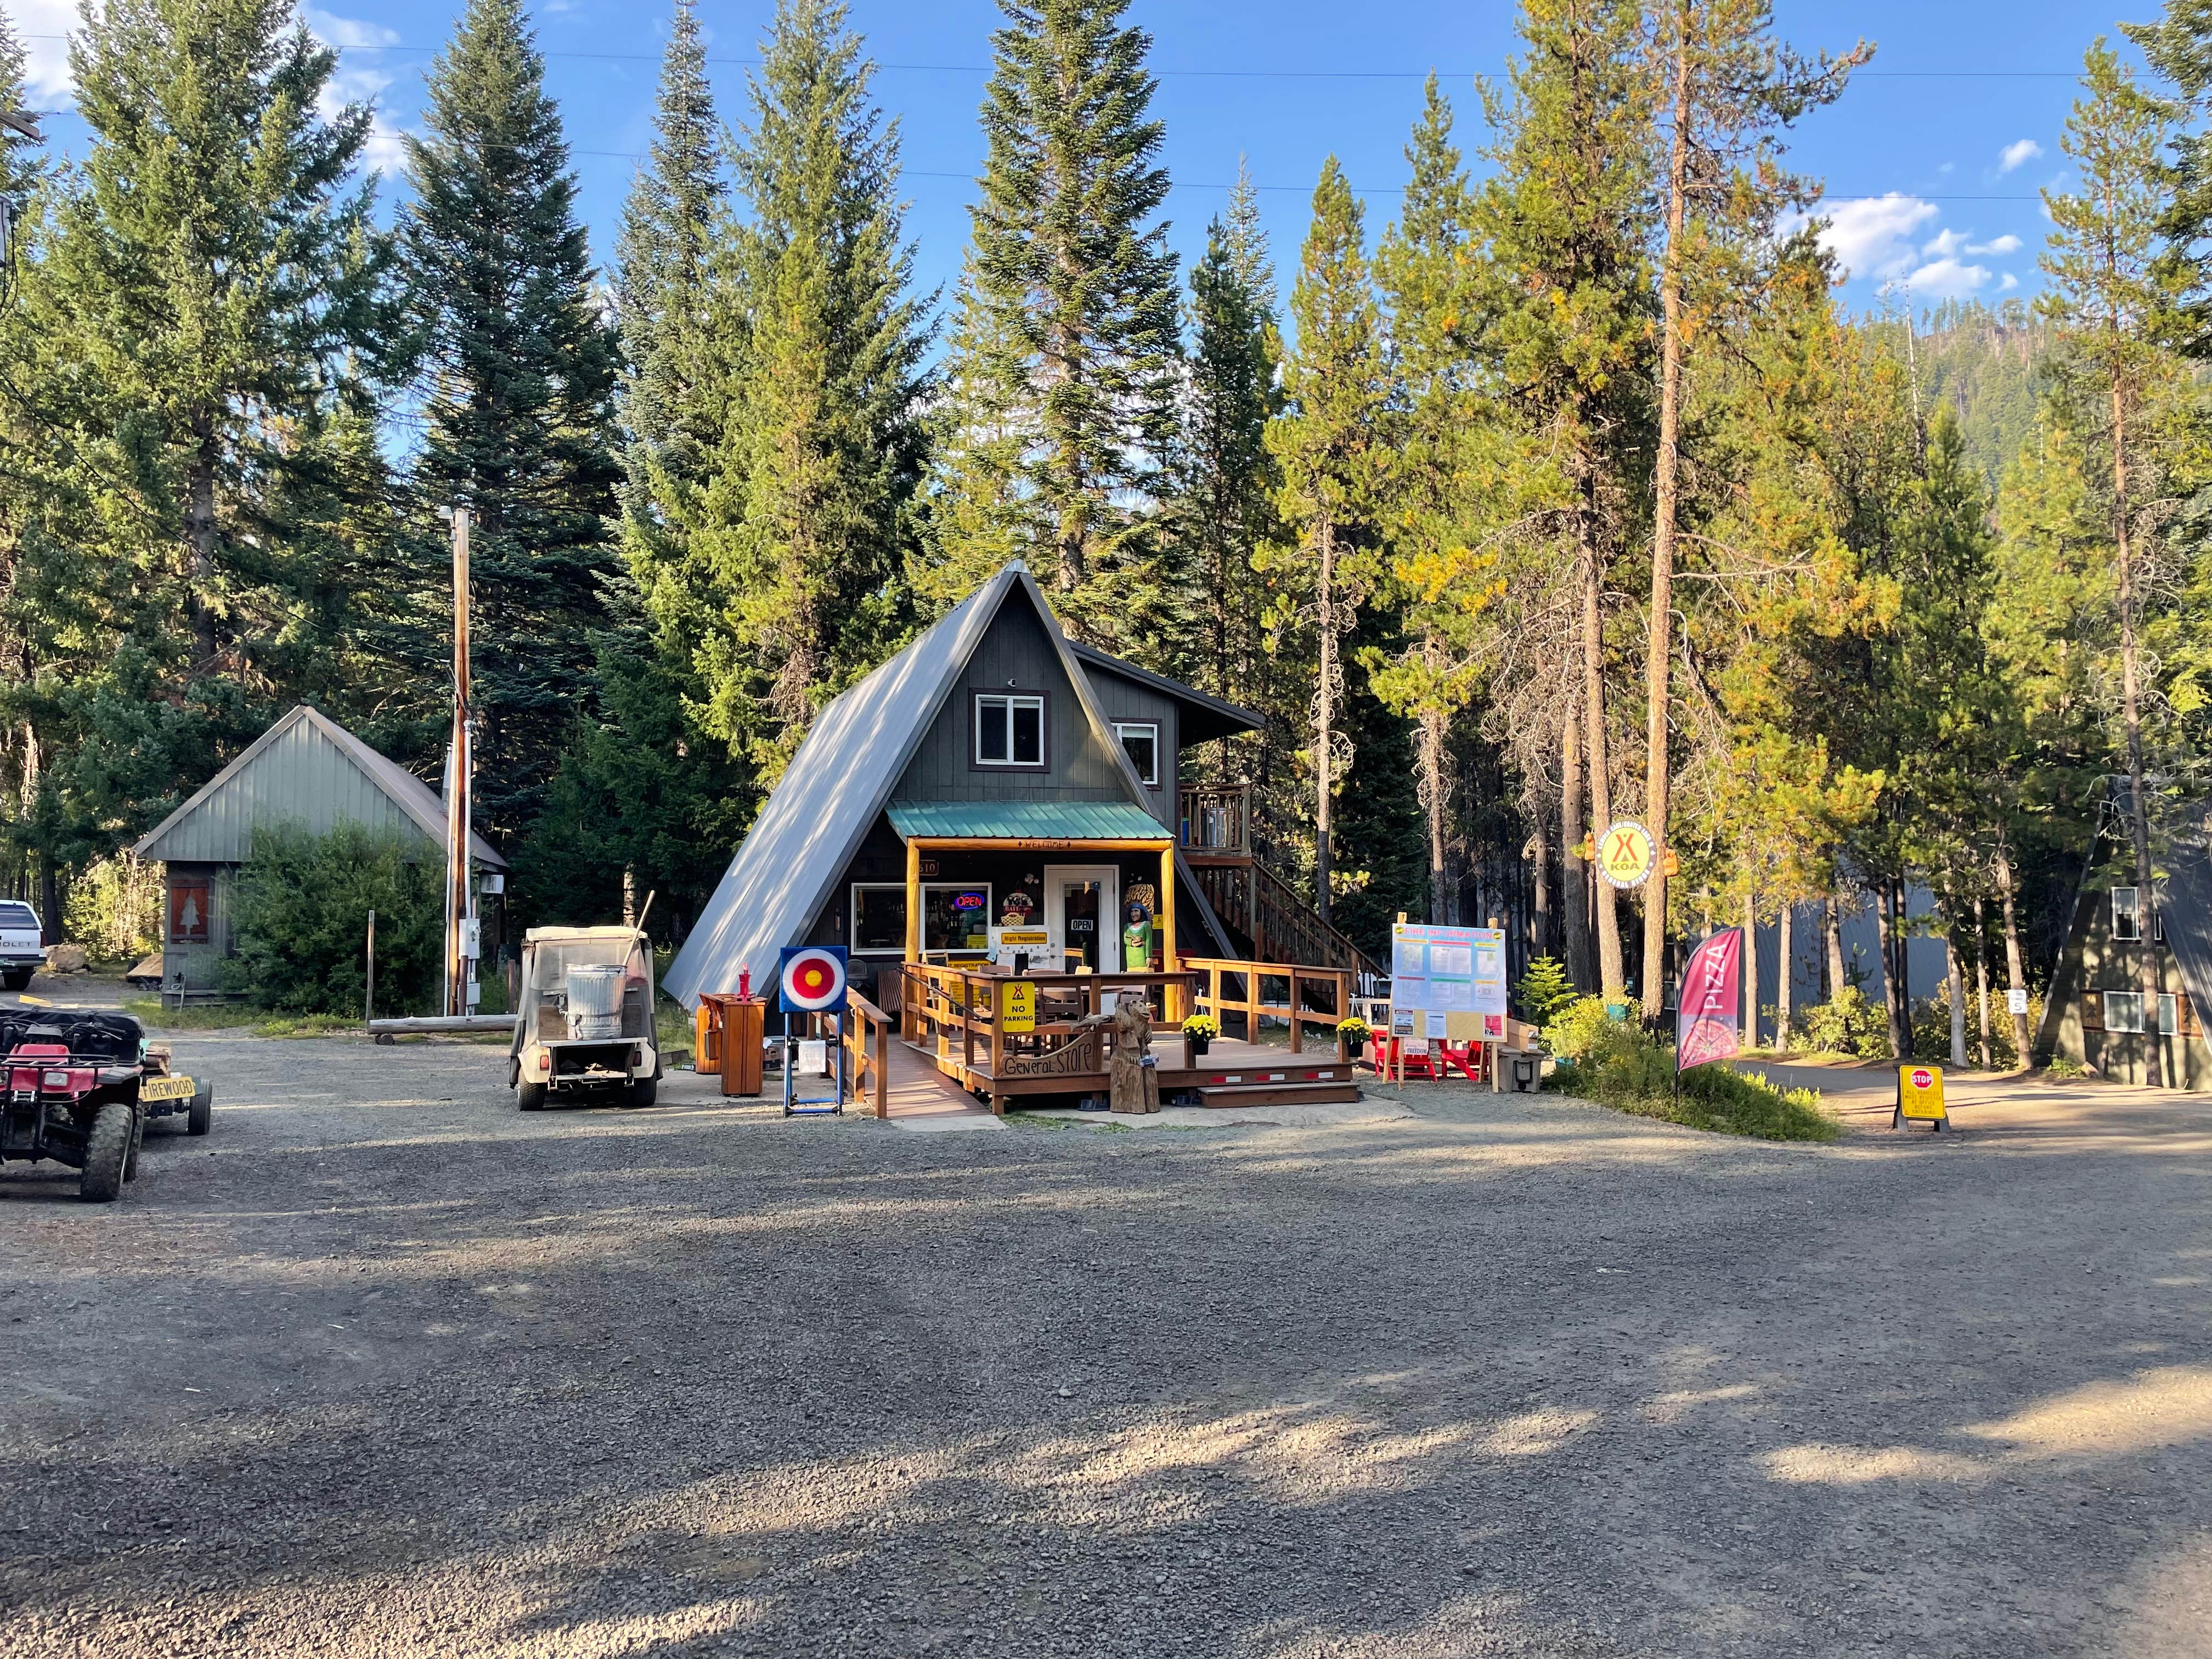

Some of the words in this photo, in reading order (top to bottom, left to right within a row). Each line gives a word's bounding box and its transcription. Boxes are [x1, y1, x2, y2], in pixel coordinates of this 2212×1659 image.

[1025, 840, 1064, 849] WELCOME
[1610, 862, 1640, 871] KOA
[957, 896, 982, 906] OPEN
[1007, 895, 1029, 906] ICE
[1073, 920, 1092, 929] OPEN
[1404, 927, 1425, 936] FIRE
[1428, 928, 1493, 939] INFORMATION
[1703, 943, 1727, 1009] PIZZA
[1912, 1075, 1932, 1084] STOP
[143, 1080, 193, 1099] FIREWOOD
